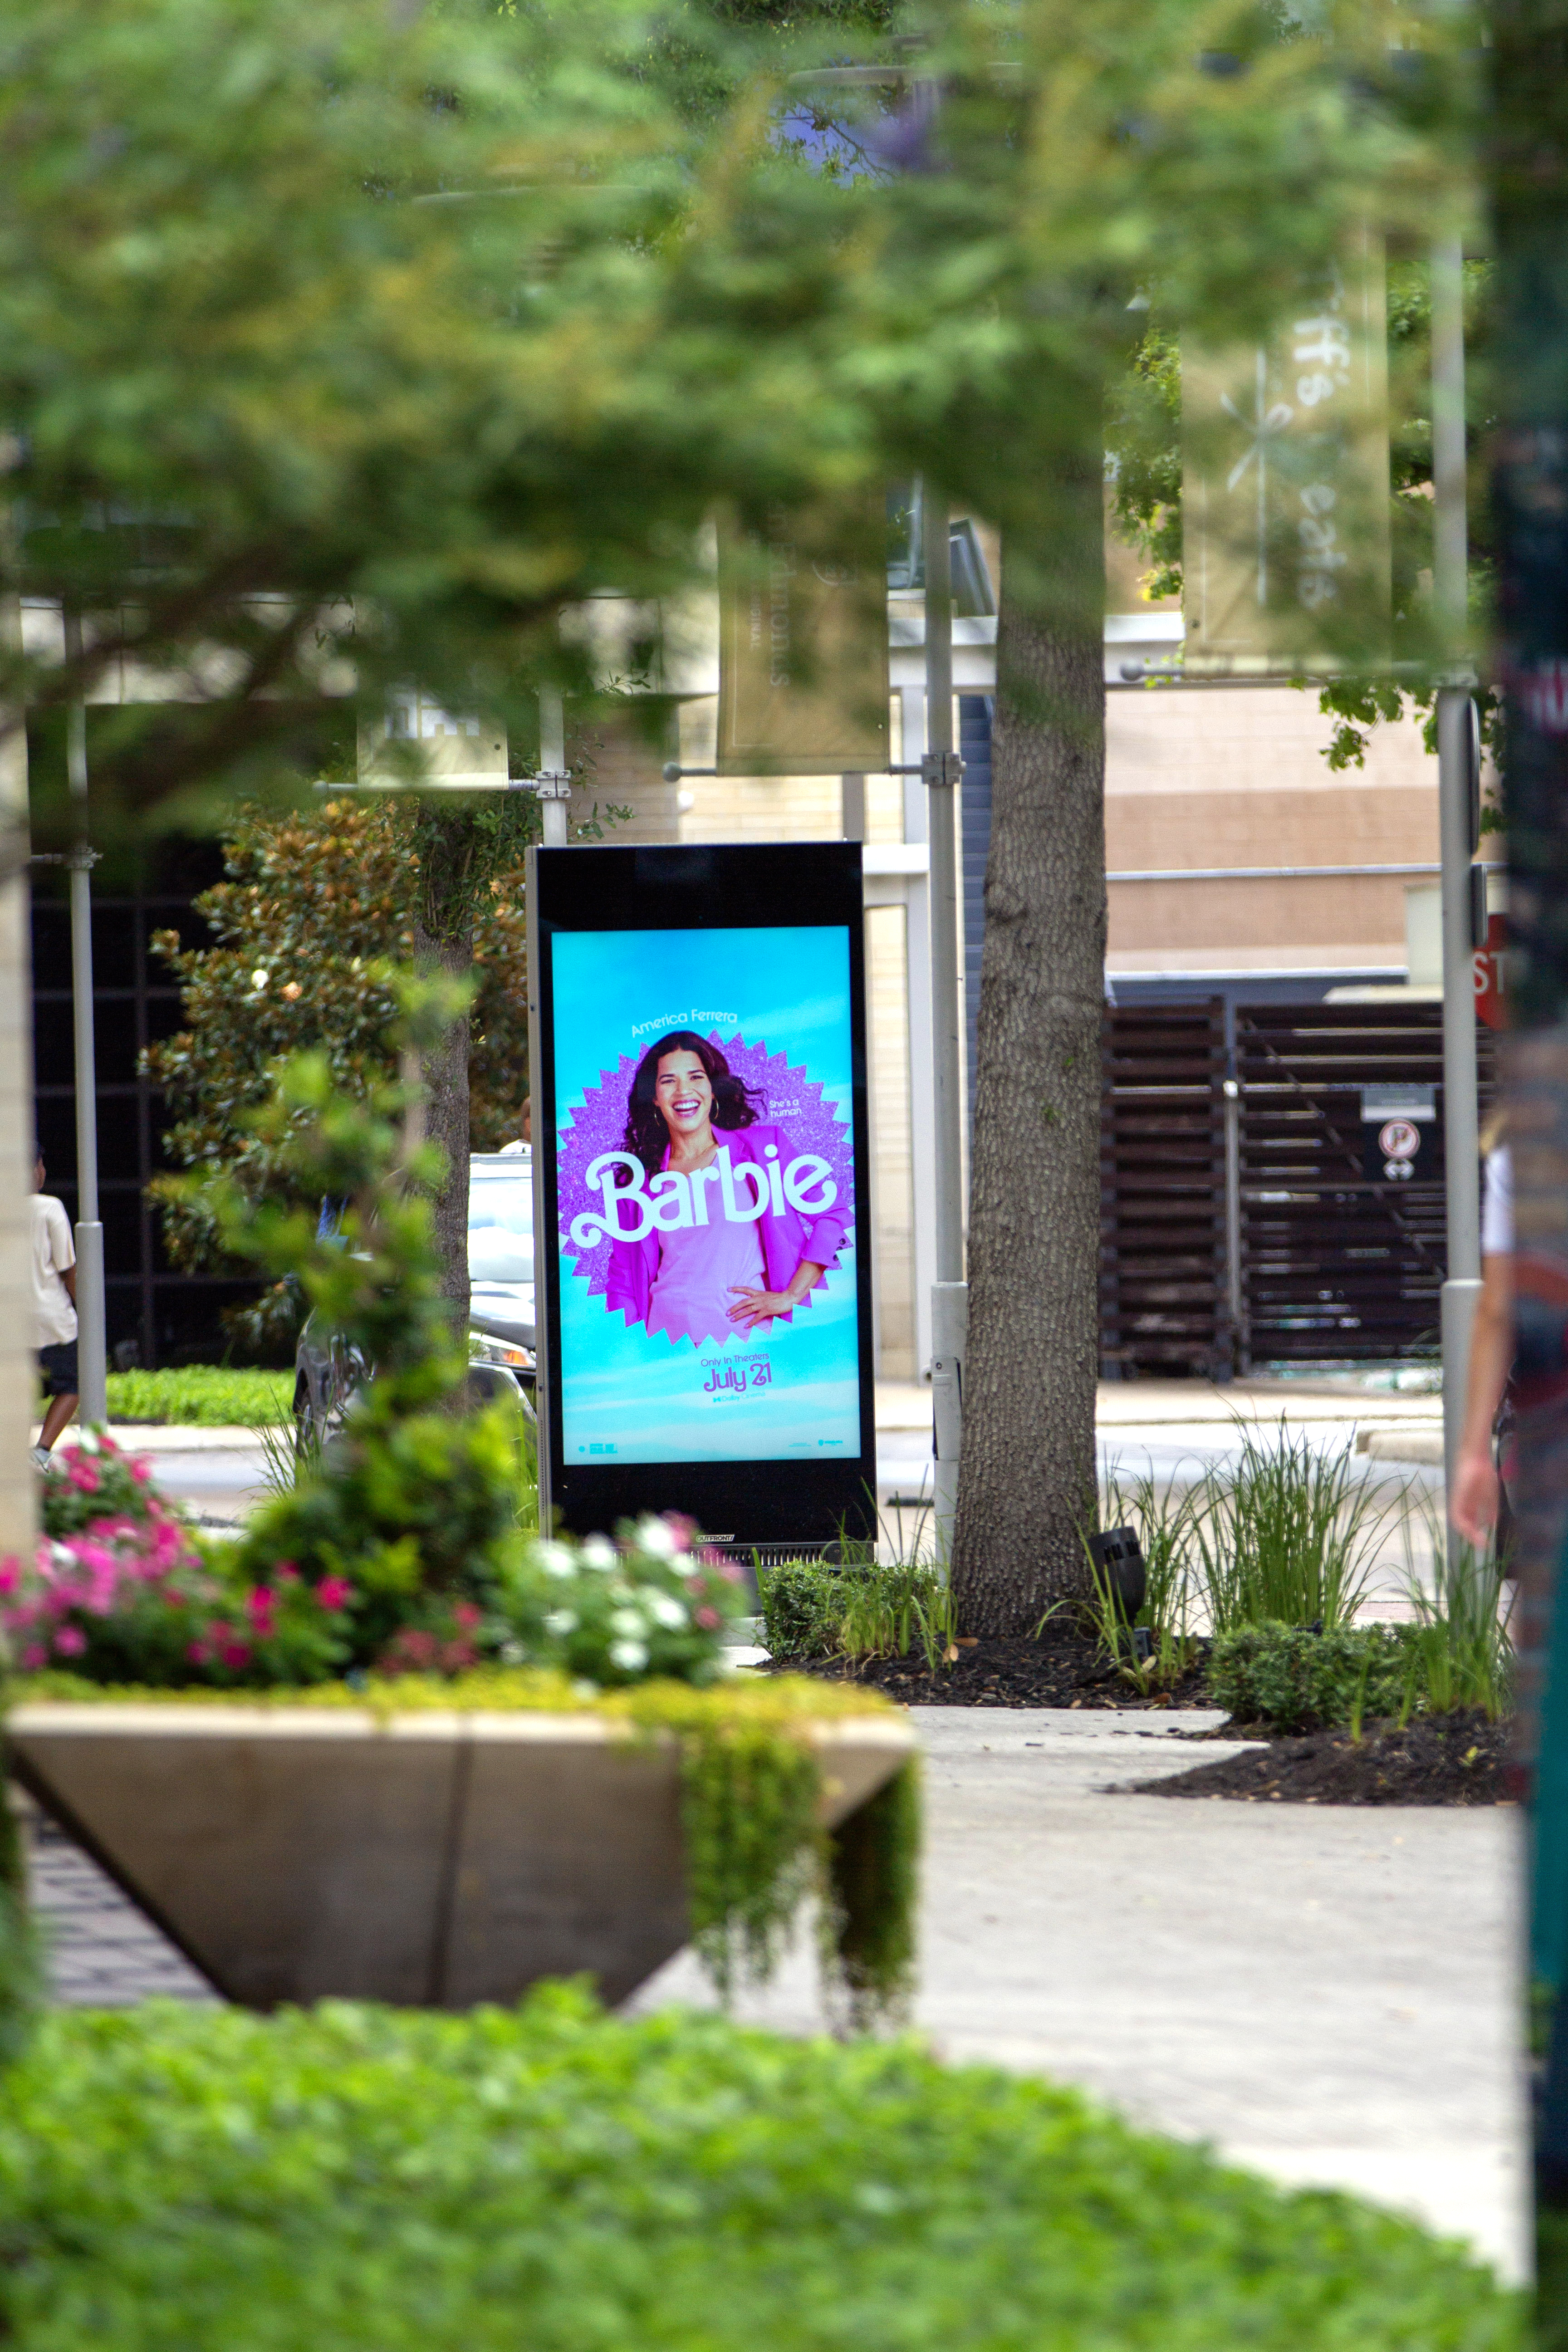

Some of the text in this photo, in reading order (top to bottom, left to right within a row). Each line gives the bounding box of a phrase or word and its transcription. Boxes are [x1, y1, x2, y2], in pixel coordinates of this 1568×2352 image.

[1294, 259, 1352, 407] Tff's
[632, 1009, 737, 1038] America Ferrera
[769, 1099, 791, 1108] She's
[570, 1144, 838, 1249] Barbie
[701, 1358, 721, 1367] Only
[734, 1353, 769, 1363] Theaters
[704, 1362, 772, 1392] July 21
